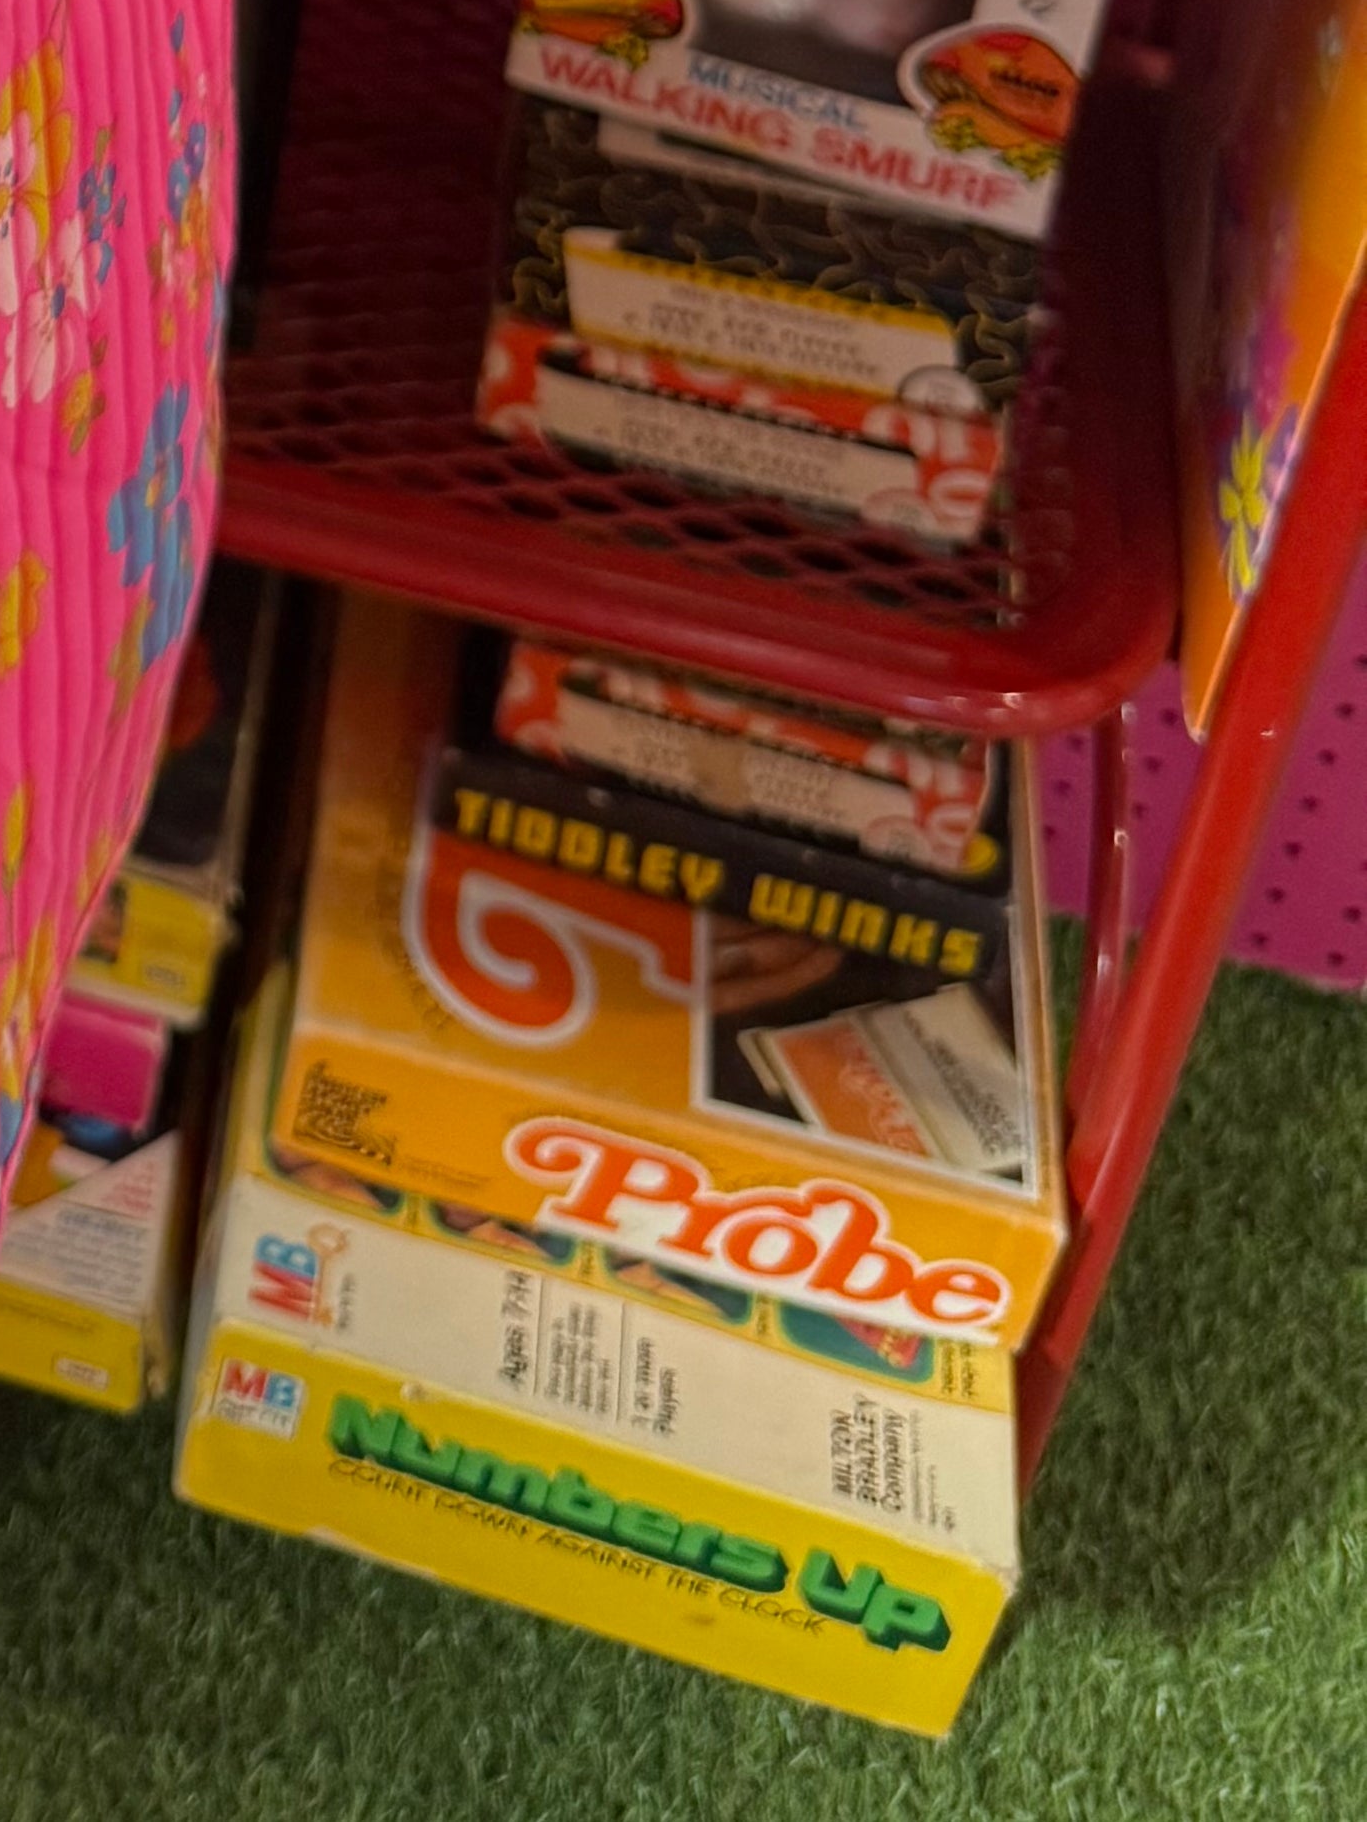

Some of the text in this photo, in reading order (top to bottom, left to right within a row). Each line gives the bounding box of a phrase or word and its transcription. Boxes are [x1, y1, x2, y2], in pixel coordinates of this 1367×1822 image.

[538, 45, 1023, 212] WALKING SMURF
[688, 56, 864, 128] MUSICAL
[454, 787, 724, 905] TIDDLEY
[748, 873, 983, 975] WINKS
[505, 1118, 1009, 1331] Probe
[222, 1357, 303, 1408] MB
[327, 1390, 789, 1594] Numbers
[798, 1544, 954, 1654] Up
[329, 1457, 827, 1637] COUNT DOWN AGAINST THE CLOCK
